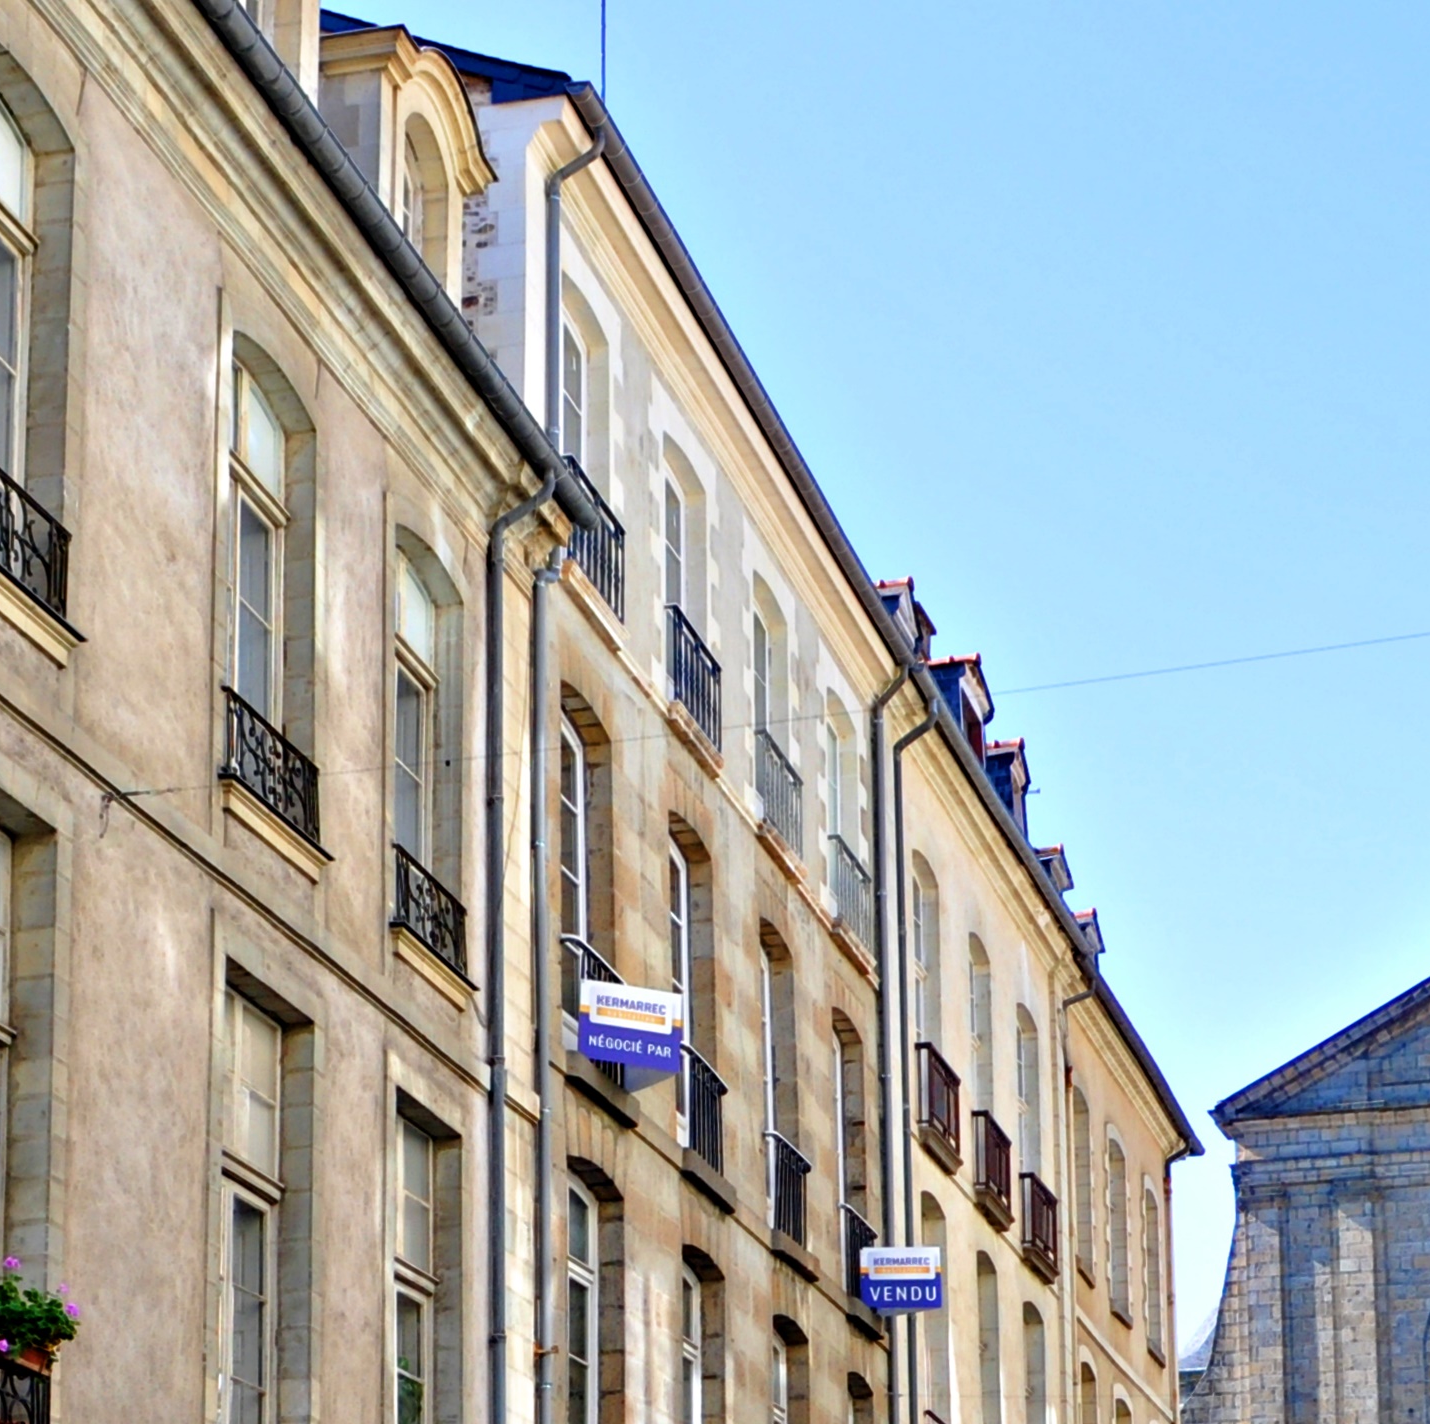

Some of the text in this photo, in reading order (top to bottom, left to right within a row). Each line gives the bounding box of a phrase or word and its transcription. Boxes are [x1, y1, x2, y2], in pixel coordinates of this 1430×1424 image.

[596, 994, 667, 1016] KERMARREC
[588, 1034, 672, 1059] NÉGOCIÉ PAR
[873, 1256, 930, 1266] KERMARREC
[869, 1286, 937, 1301] VENDU
